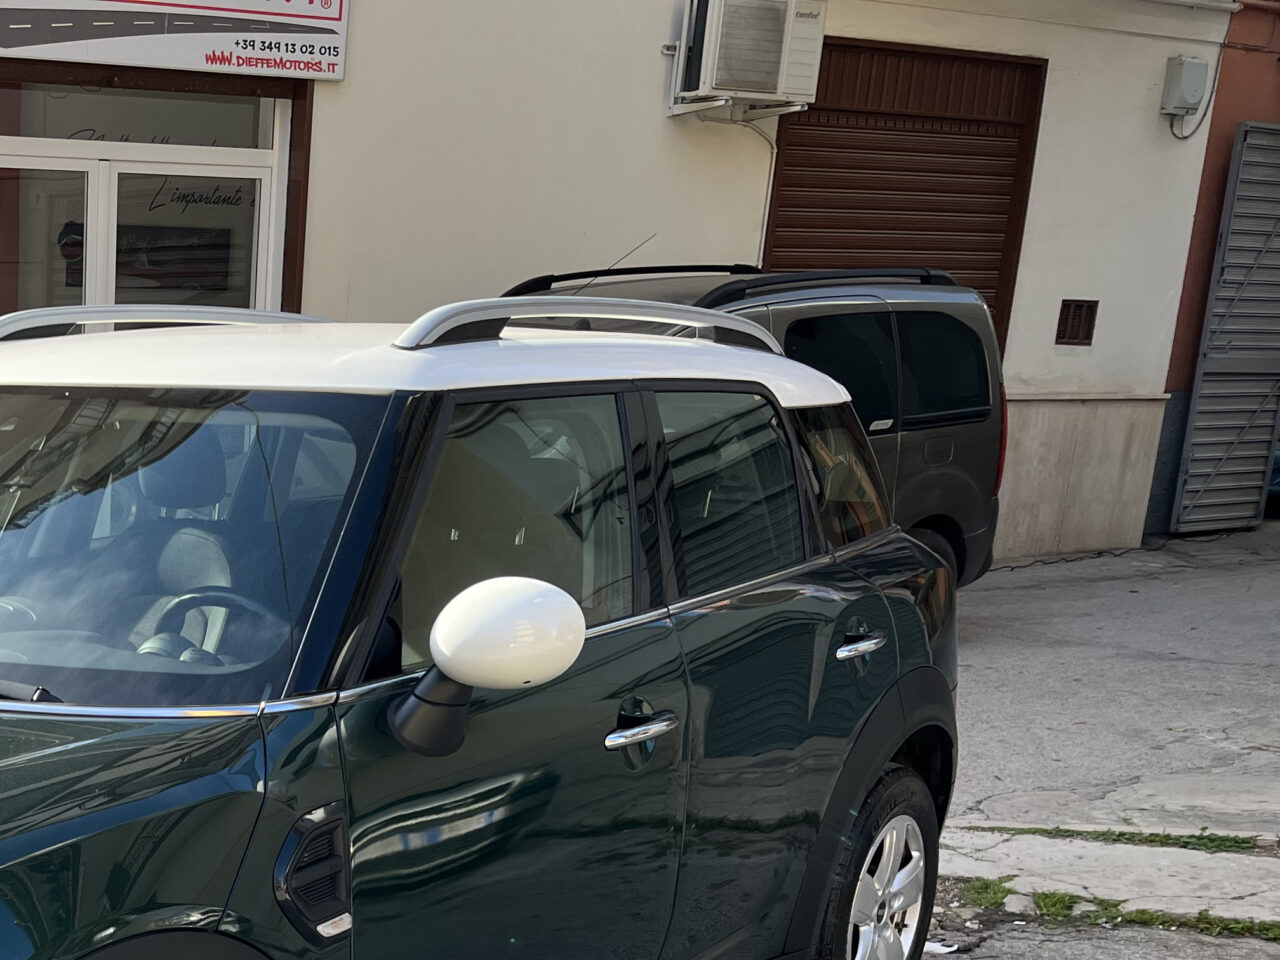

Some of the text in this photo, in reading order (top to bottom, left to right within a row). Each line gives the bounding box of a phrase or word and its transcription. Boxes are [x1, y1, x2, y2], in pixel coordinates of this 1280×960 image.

[234, 39, 340, 57] +39 349 13 02 015
